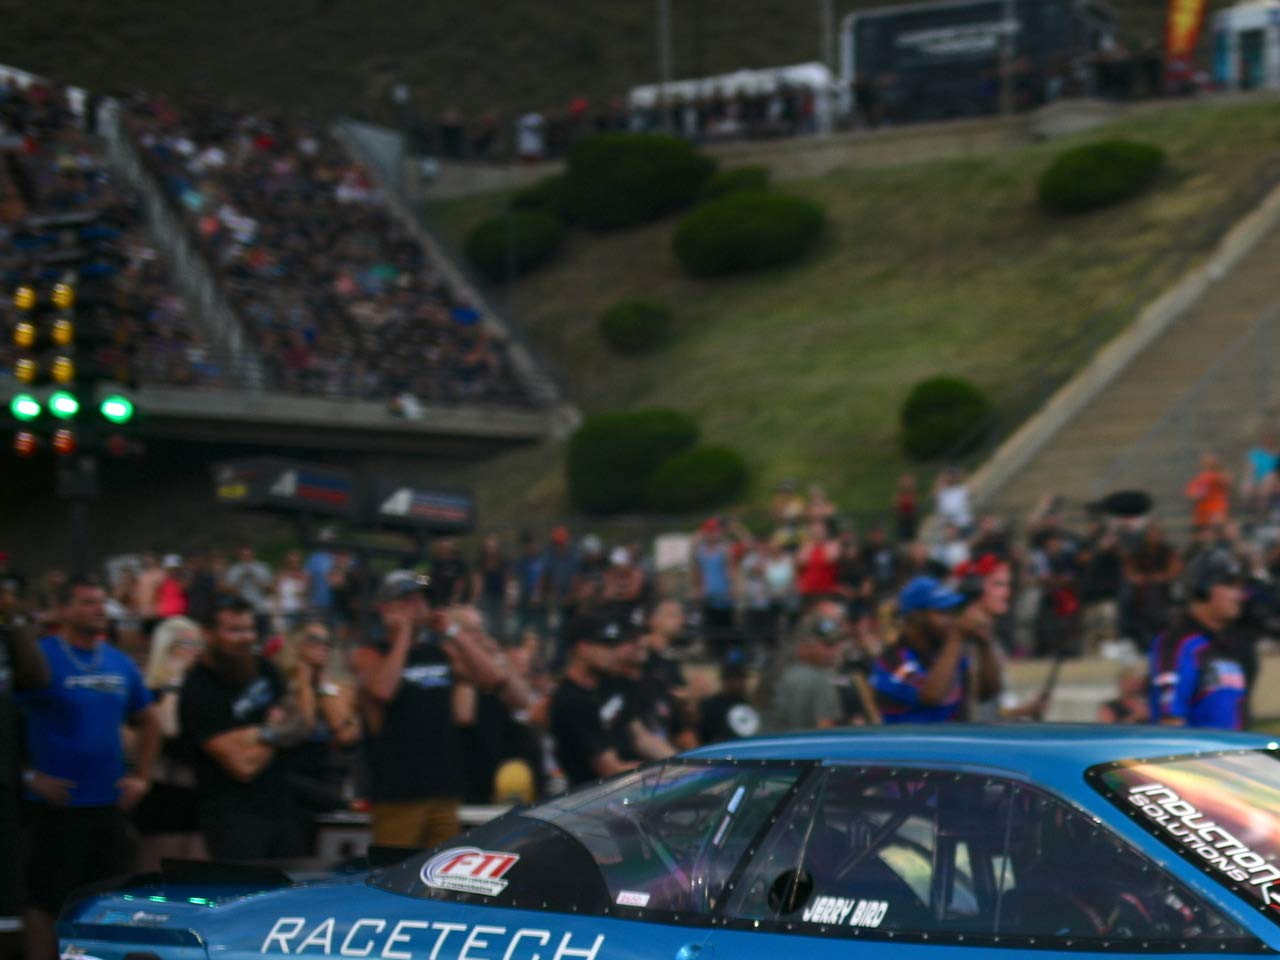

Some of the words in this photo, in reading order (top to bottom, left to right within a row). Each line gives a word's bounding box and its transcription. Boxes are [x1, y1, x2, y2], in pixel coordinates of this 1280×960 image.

[1128, 794, 1250, 882] SOLUTIONS
[441, 853, 519, 879] FTI
[802, 896, 855, 925] JERRY
[849, 899, 889, 928] BIRD
